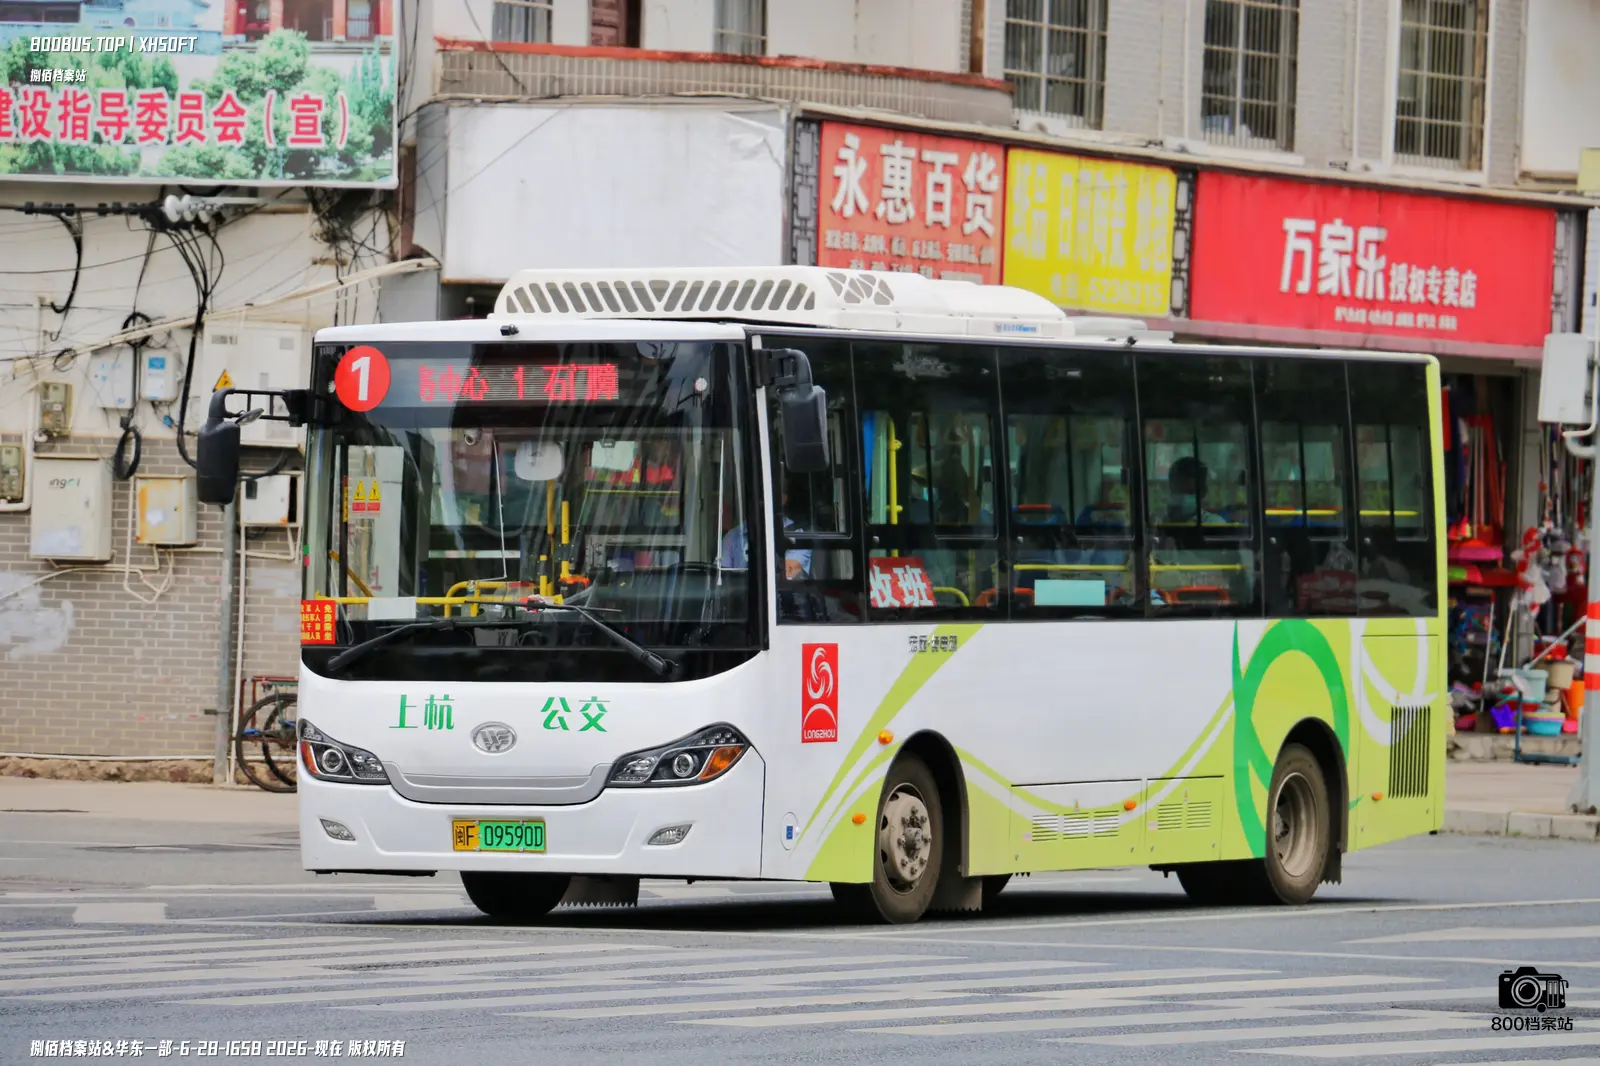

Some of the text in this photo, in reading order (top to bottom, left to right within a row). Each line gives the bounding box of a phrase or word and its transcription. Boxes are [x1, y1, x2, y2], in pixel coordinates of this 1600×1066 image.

[831, 132, 1000, 240] 永惠百货
[1280, 217, 1478, 309] 万家乐 授权专卖店
[351, 356, 371, 401] 1
[513, 366, 525, 400] 1
[389, 694, 611, 732] 上杭 公交
[803, 729, 836, 739] LONGZHOU
[484, 825, 543, 847] 09590D
